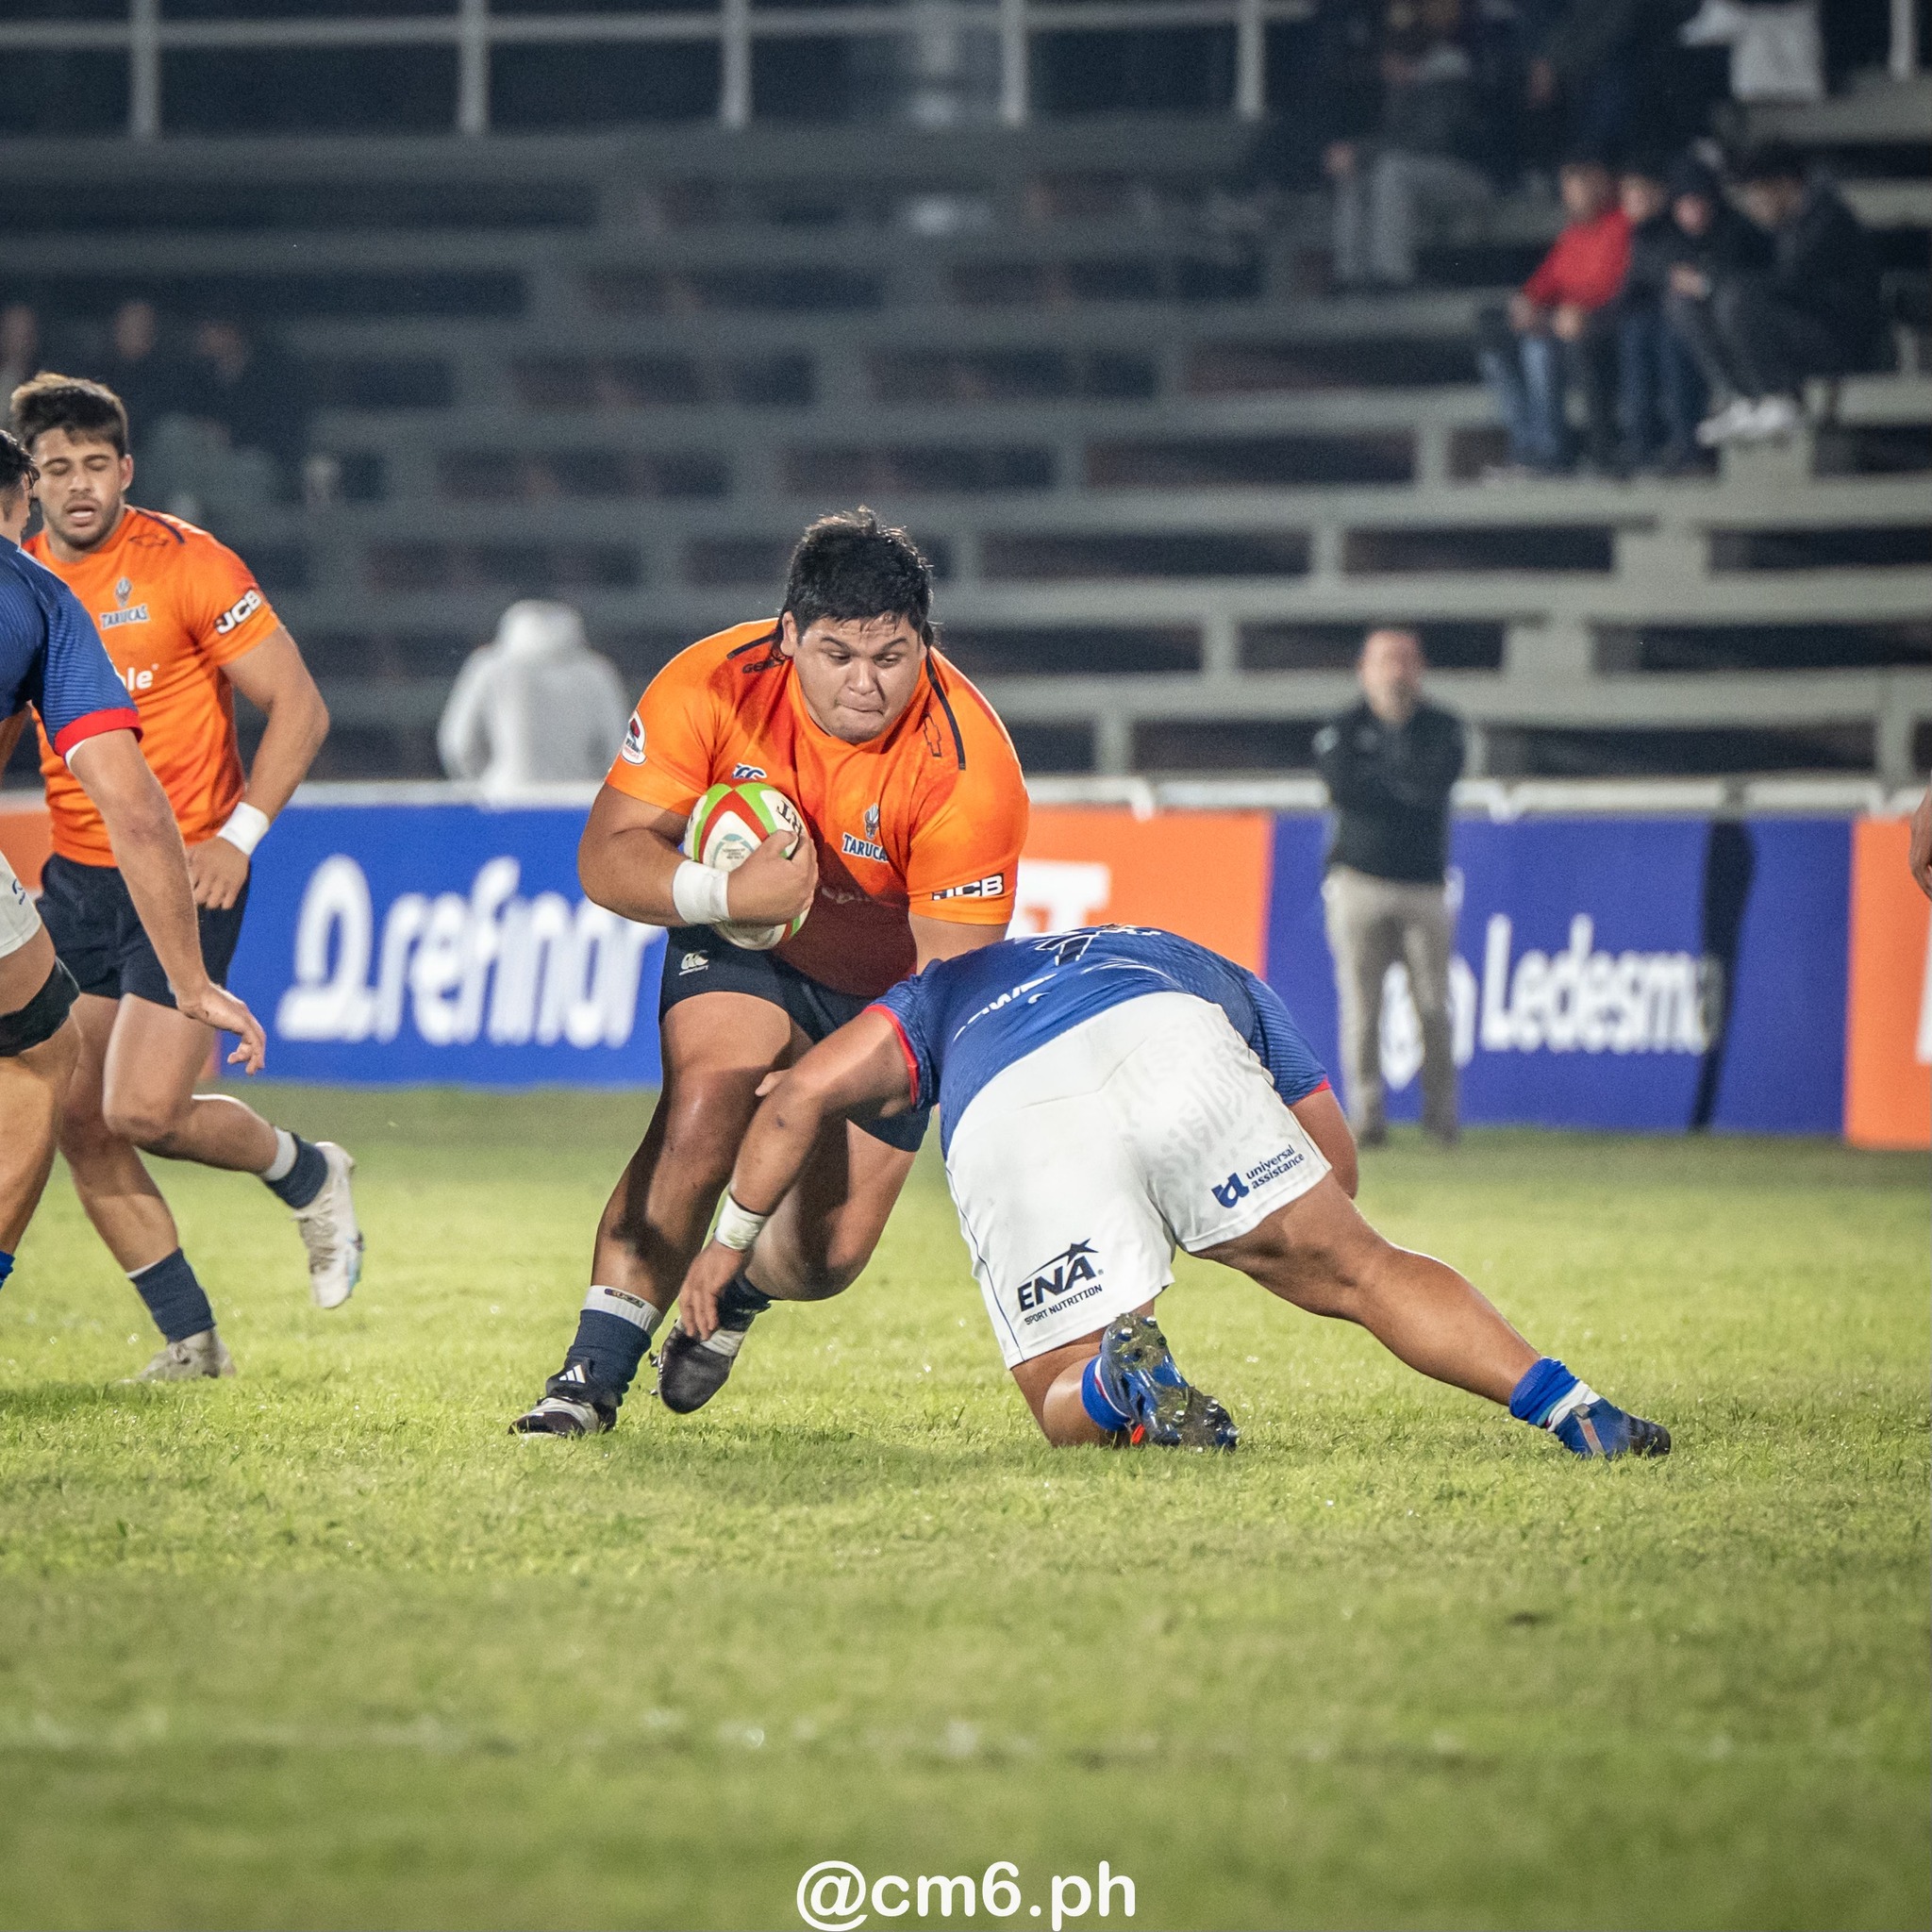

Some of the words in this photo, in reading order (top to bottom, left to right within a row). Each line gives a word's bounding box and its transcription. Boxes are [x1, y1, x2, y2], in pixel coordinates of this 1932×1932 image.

[215, 590, 262, 634] JCB
[842, 833, 891, 862] TARUCA
[1245, 1143, 1295, 1179] universal
[1252, 1153, 1305, 1189] assistance
[1017, 1255, 1097, 1312] ENA
[1024, 1308, 1049, 1325] SPORT
[1048, 1284, 1103, 1315] NUTRITION
